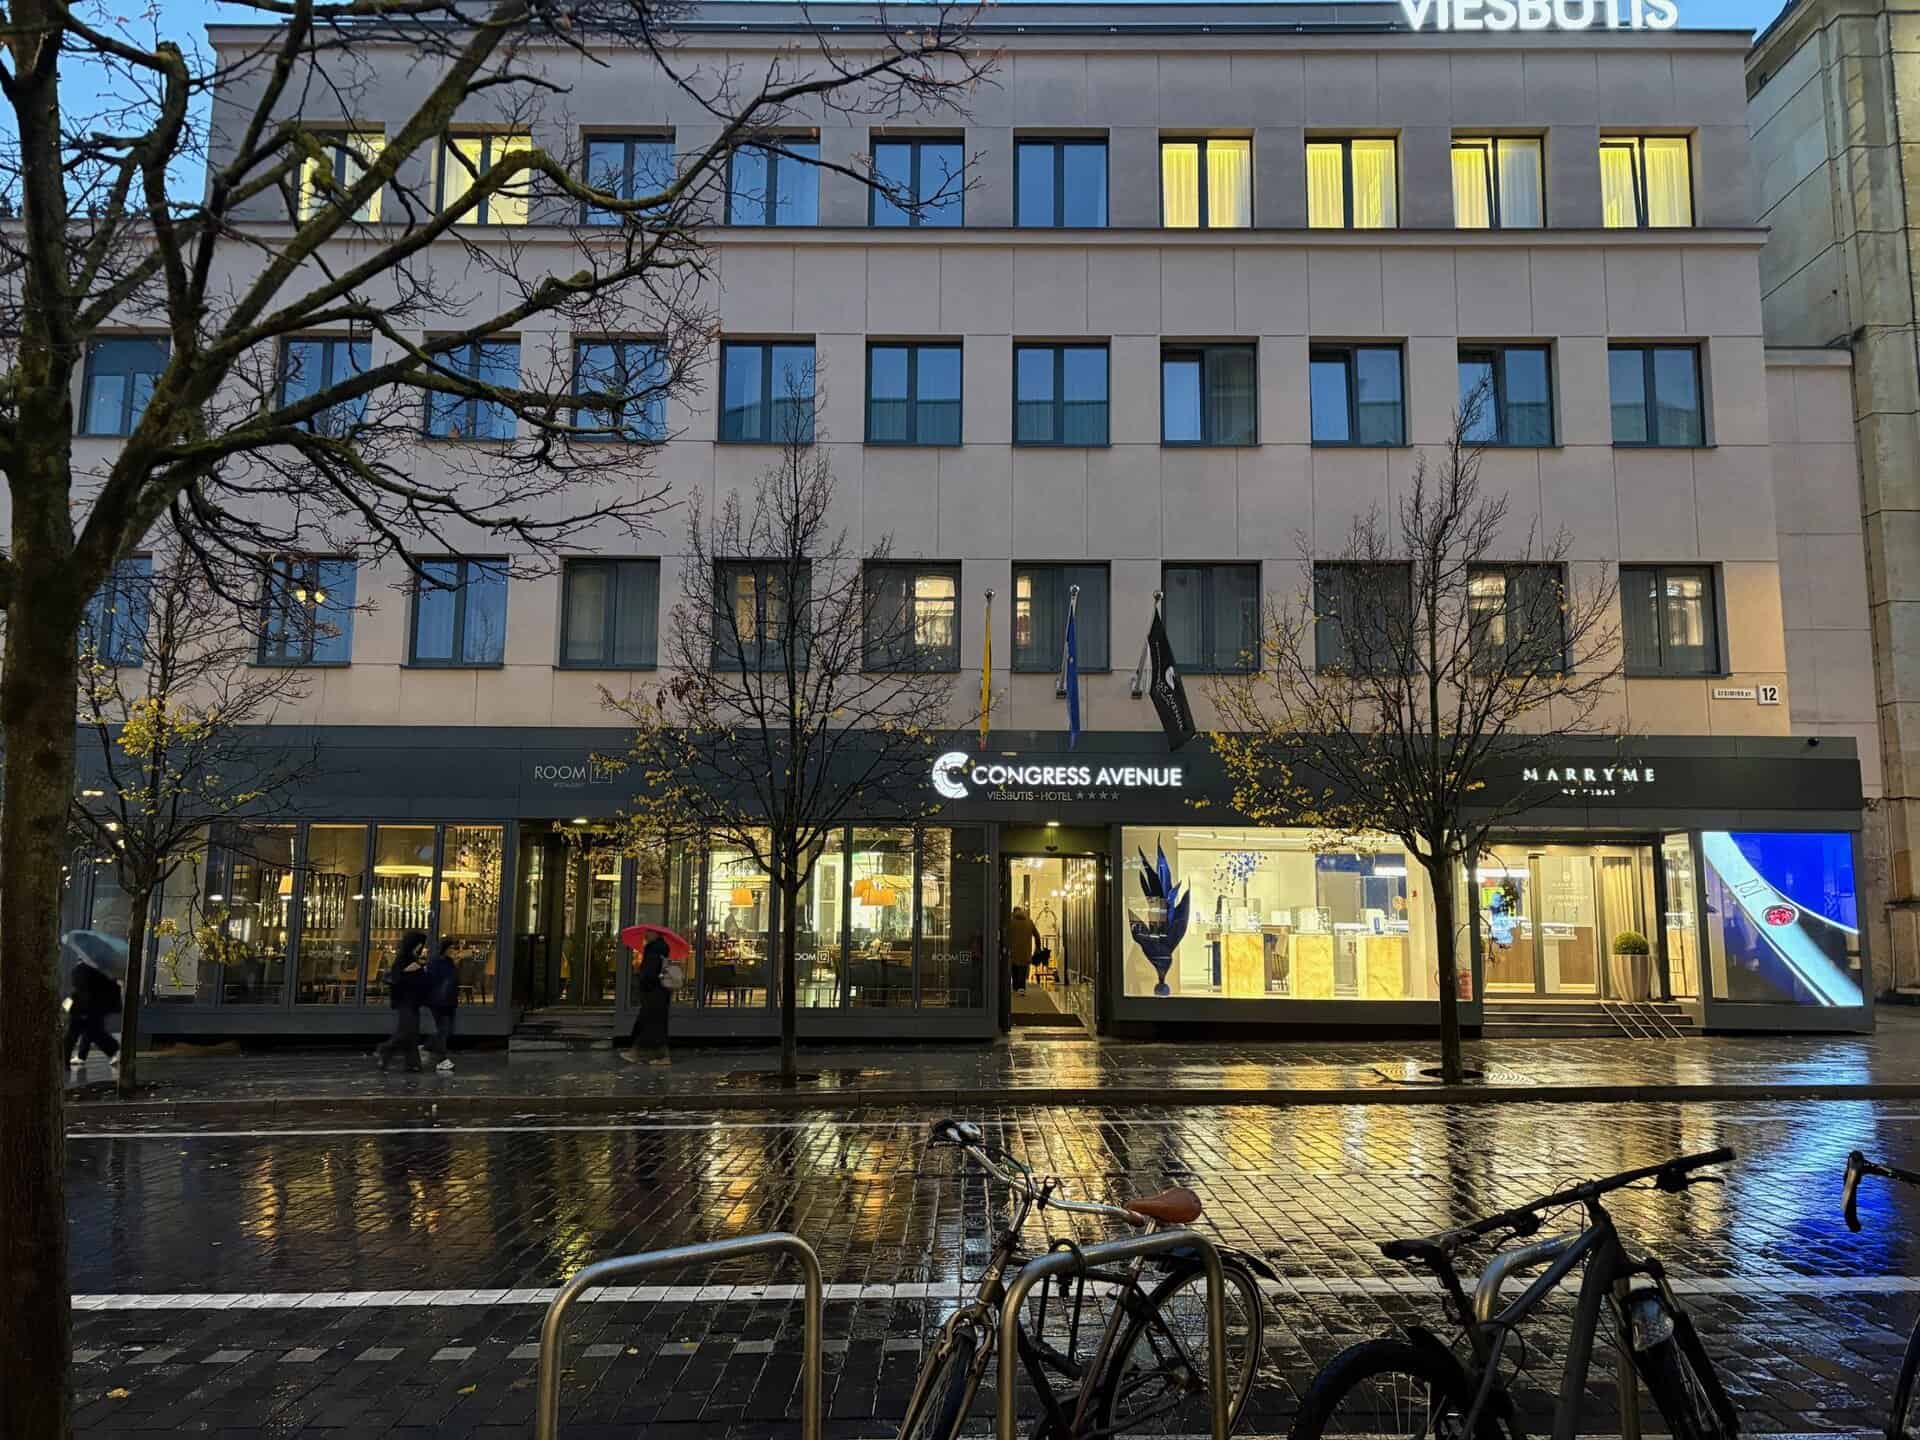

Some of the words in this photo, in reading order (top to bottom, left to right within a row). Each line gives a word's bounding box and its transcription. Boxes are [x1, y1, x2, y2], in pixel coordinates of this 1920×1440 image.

[1762, 687, 1777, 701] 12
[534, 766, 586, 779] ROOM
[971, 766, 1091, 787] CONGRESS
[1096, 766, 1183, 787] AVENUE
[1040, 791, 1073, 801] HOTEL
